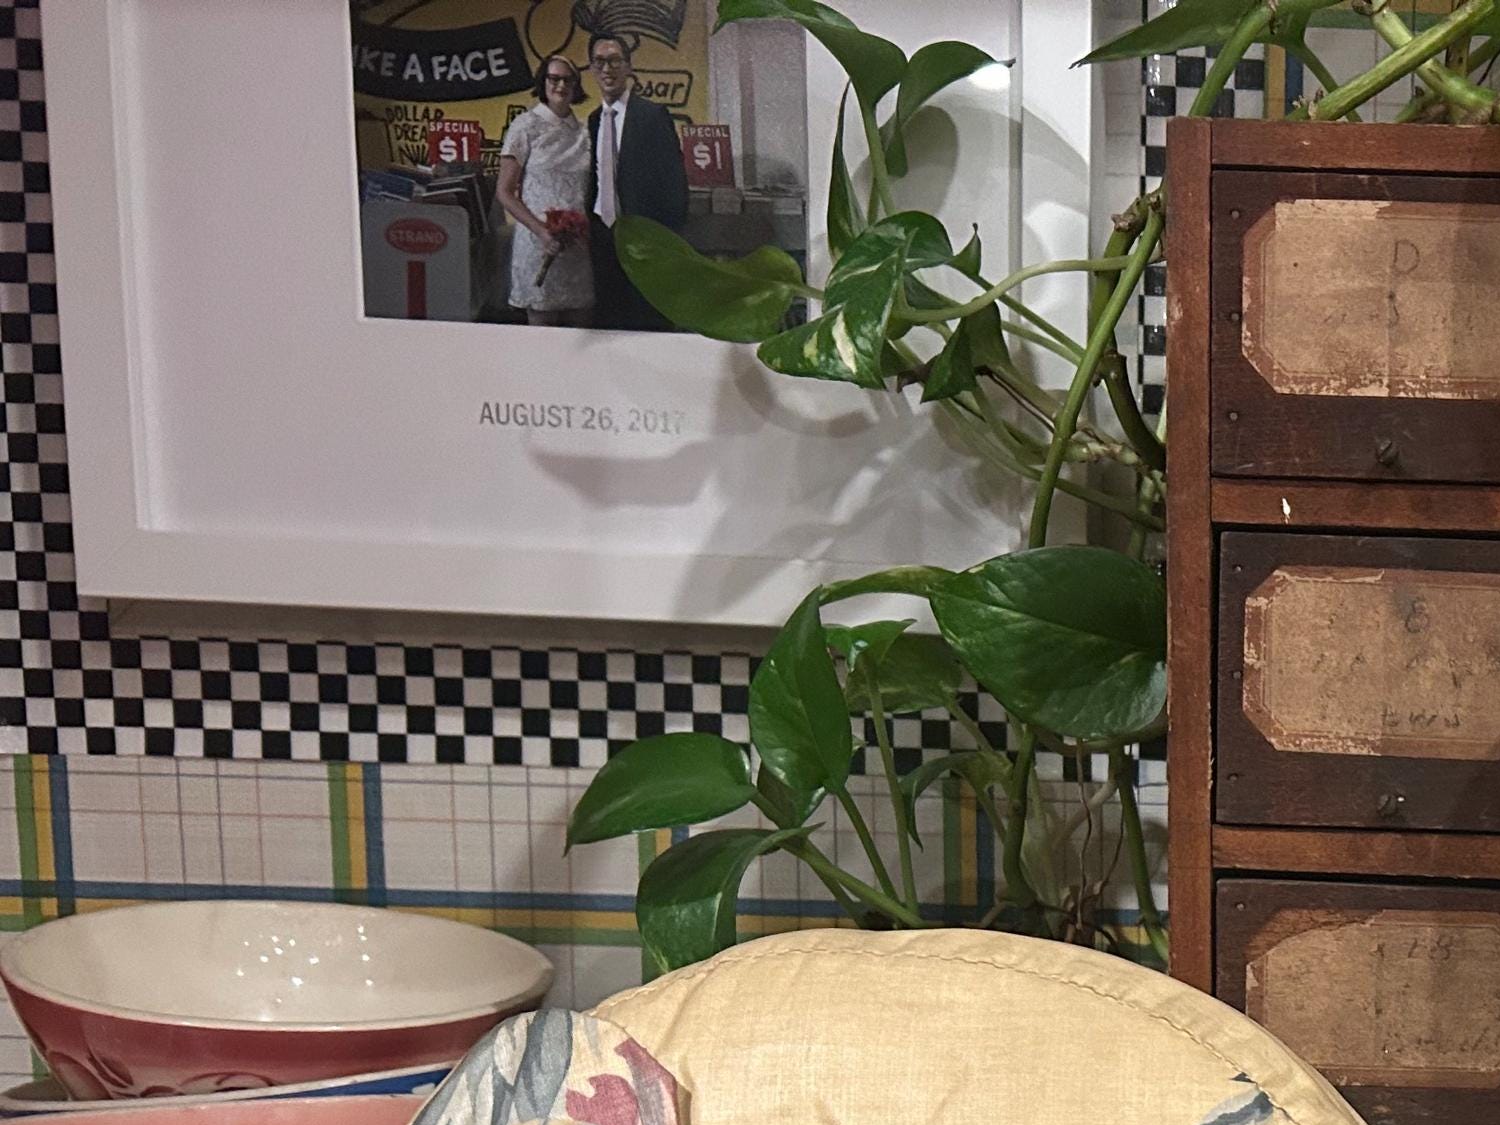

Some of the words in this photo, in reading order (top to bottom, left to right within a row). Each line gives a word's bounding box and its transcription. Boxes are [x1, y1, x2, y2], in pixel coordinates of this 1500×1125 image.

[353, 45, 396, 76] KE
[402, 53, 424, 83] A
[430, 48, 510, 80] FACE
[394, 123, 428, 142] DREA
[429, 121, 478, 133] SPECIAL
[682, 126, 729, 137] SPECIAL
[439, 136, 469, 162] $1
[692, 141, 723, 170] $1
[389, 229, 446, 245] STRAND
[480, 402, 574, 428] AUGUST
[581, 406, 620, 434] 26,
[628, 408, 685, 434] 2017
